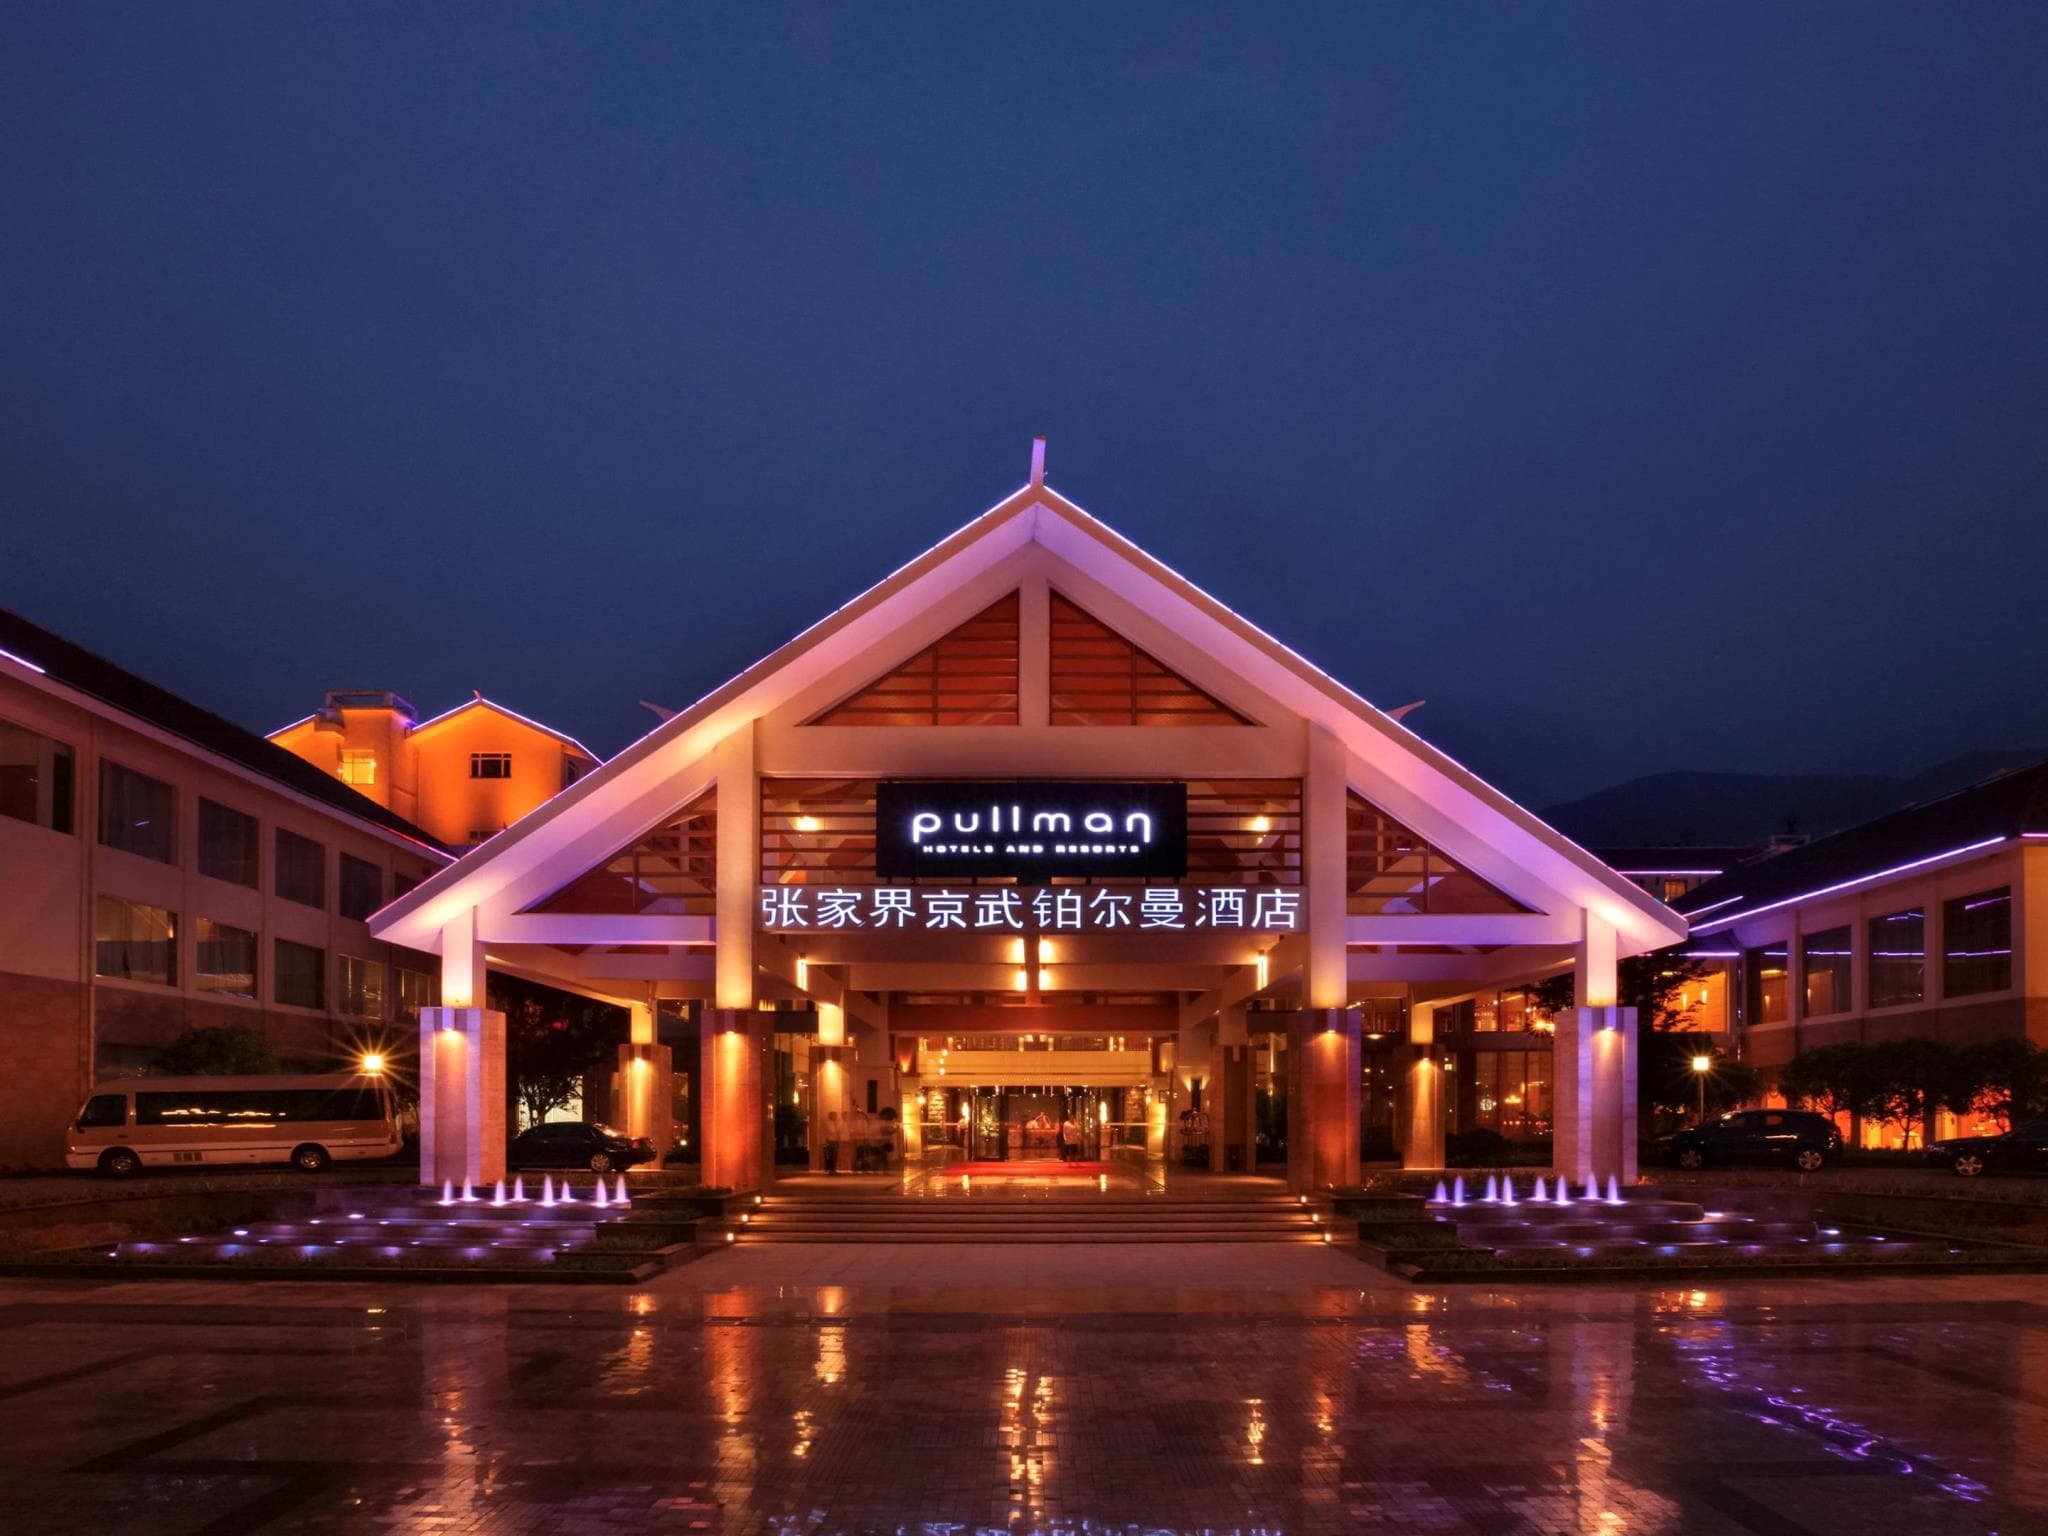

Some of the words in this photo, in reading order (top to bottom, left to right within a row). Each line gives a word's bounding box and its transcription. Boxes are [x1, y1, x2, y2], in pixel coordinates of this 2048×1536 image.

[911, 805, 1152, 844] pullman
[922, 844, 994, 854] HOTELS
[1005, 844, 1044, 854] AND
[1055, 844, 1140, 854] RESORTS
[760, 887, 1301, 929] 张家界京武铂尔曼酒店
